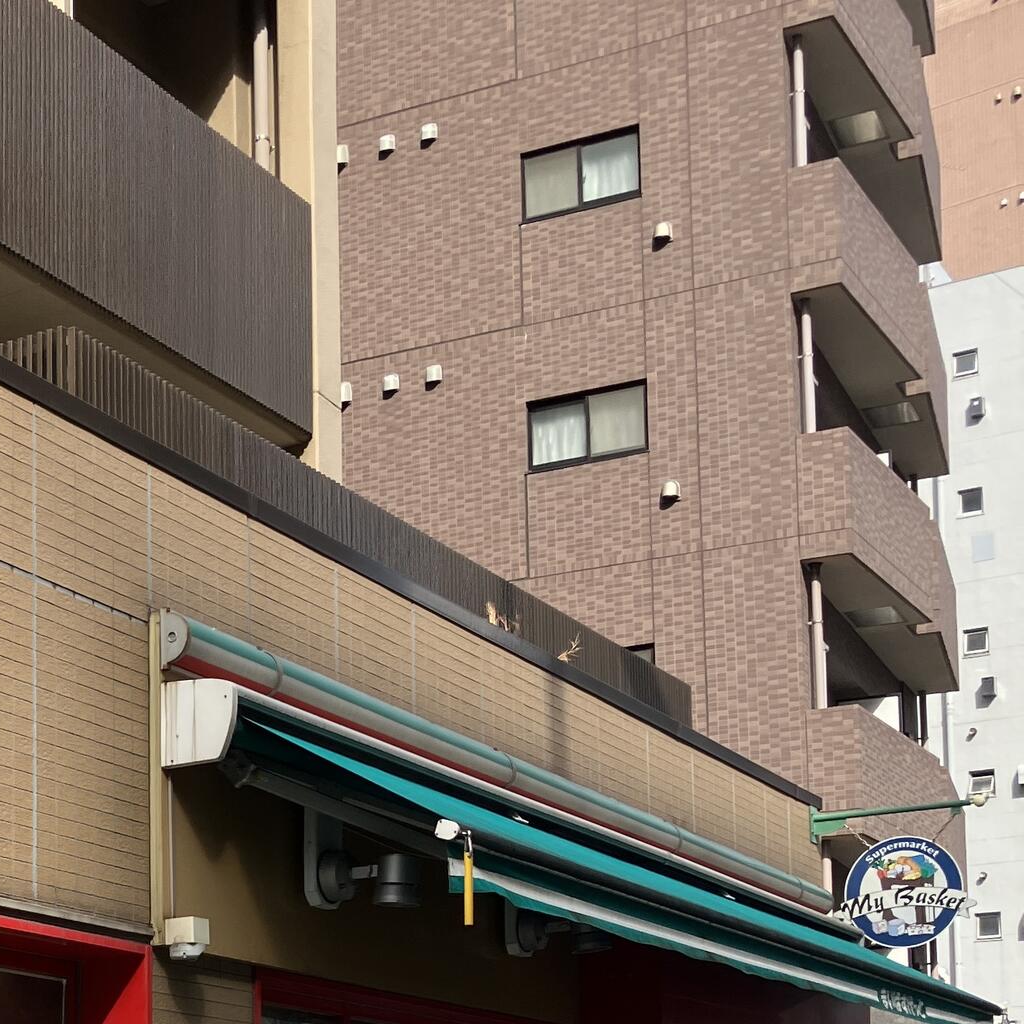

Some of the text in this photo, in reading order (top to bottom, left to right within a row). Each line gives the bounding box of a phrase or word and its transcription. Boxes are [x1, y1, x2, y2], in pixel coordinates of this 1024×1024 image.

[864, 840, 940, 864] Supermarket
[841, 886, 967, 919] My Basket
